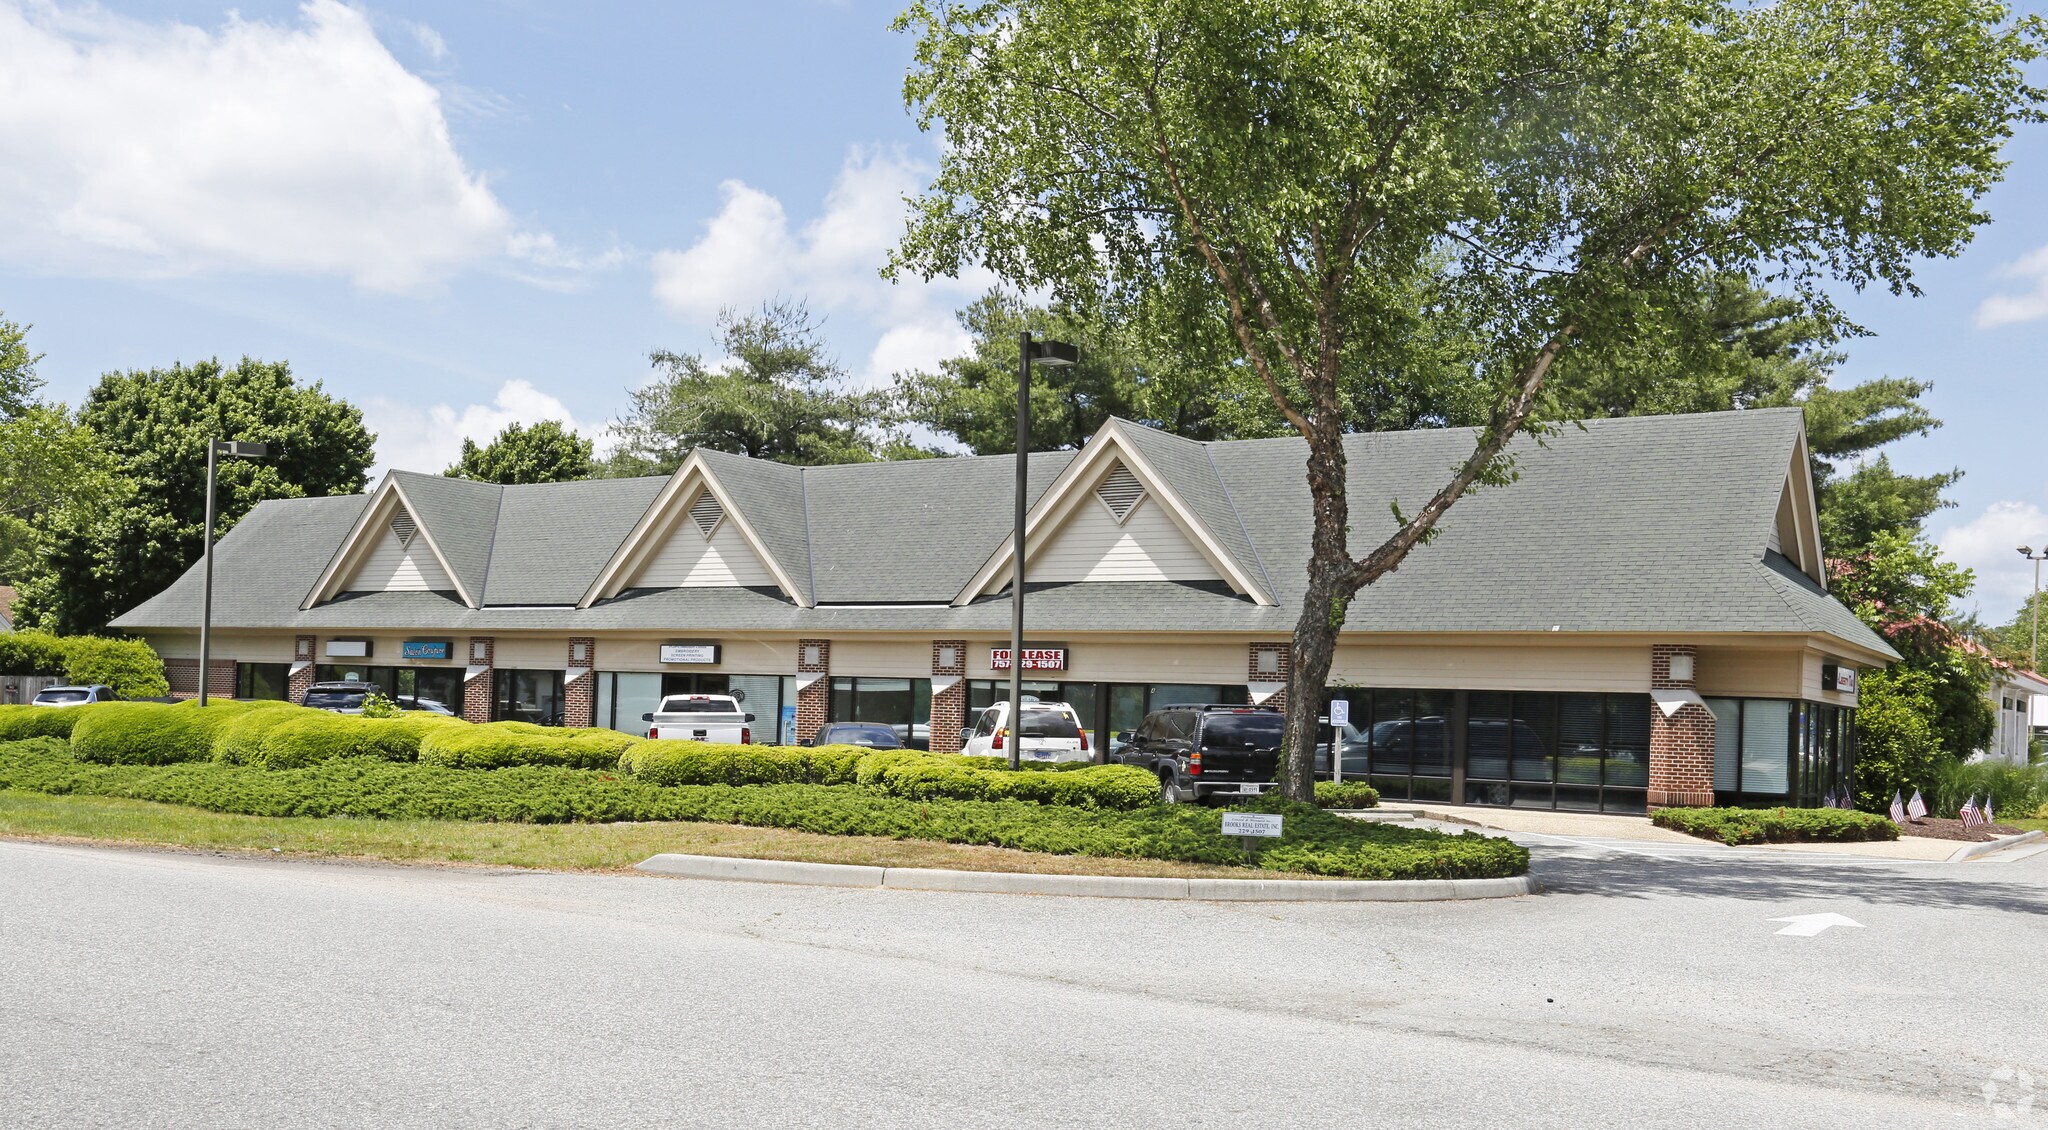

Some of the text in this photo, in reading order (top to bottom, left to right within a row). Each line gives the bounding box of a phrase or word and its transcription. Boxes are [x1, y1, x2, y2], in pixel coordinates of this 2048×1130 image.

[993, 650, 1061, 659] FO LEASE
[994, 660, 1061, 669] 757-29-1507
